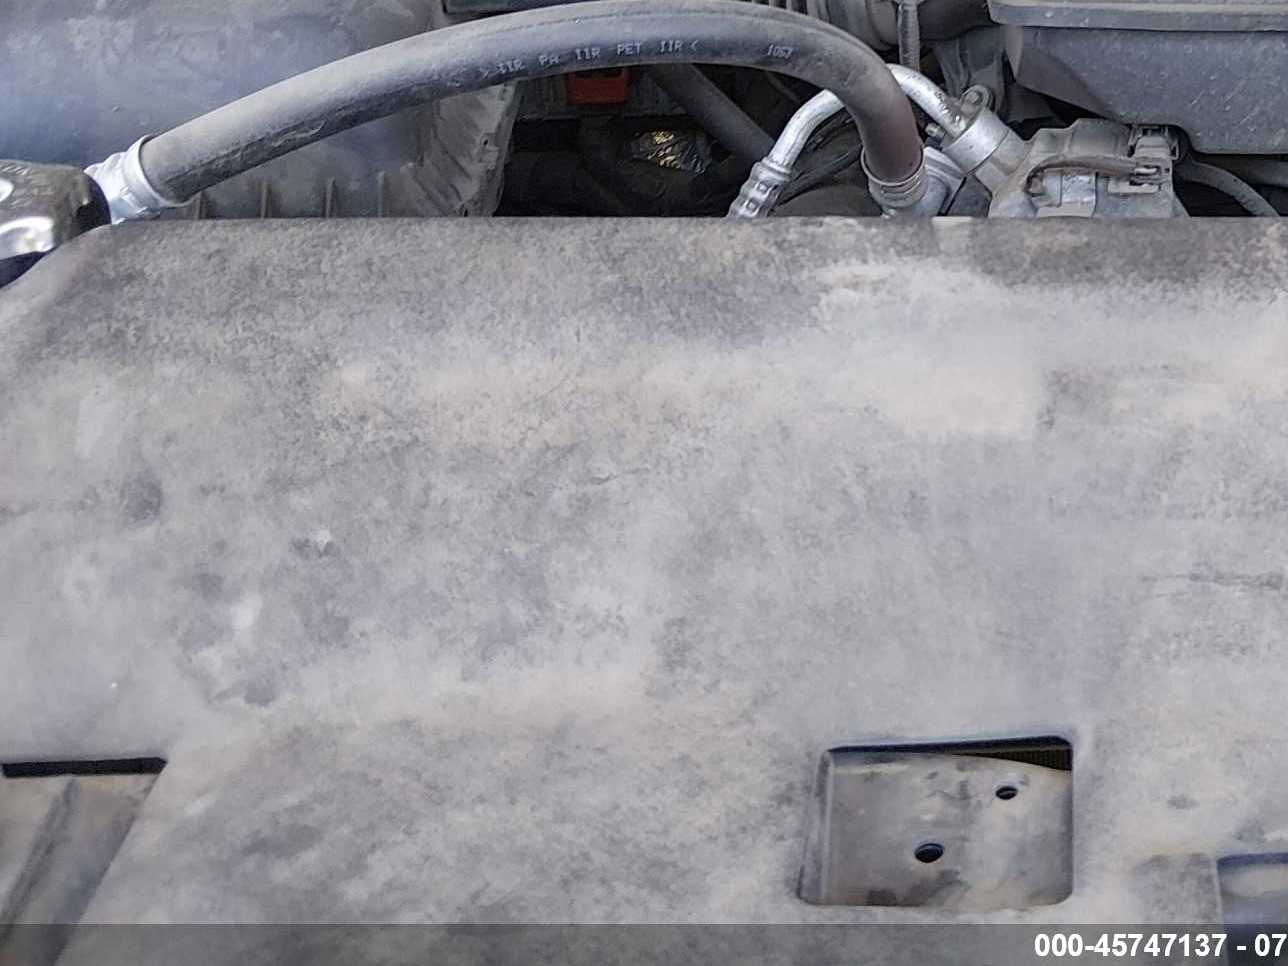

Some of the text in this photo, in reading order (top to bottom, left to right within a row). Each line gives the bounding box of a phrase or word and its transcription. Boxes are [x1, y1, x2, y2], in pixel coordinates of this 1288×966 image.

[575, 46, 601, 61] IIR
[617, 41, 643, 56] PET
[660, 39, 683, 53] IIR
